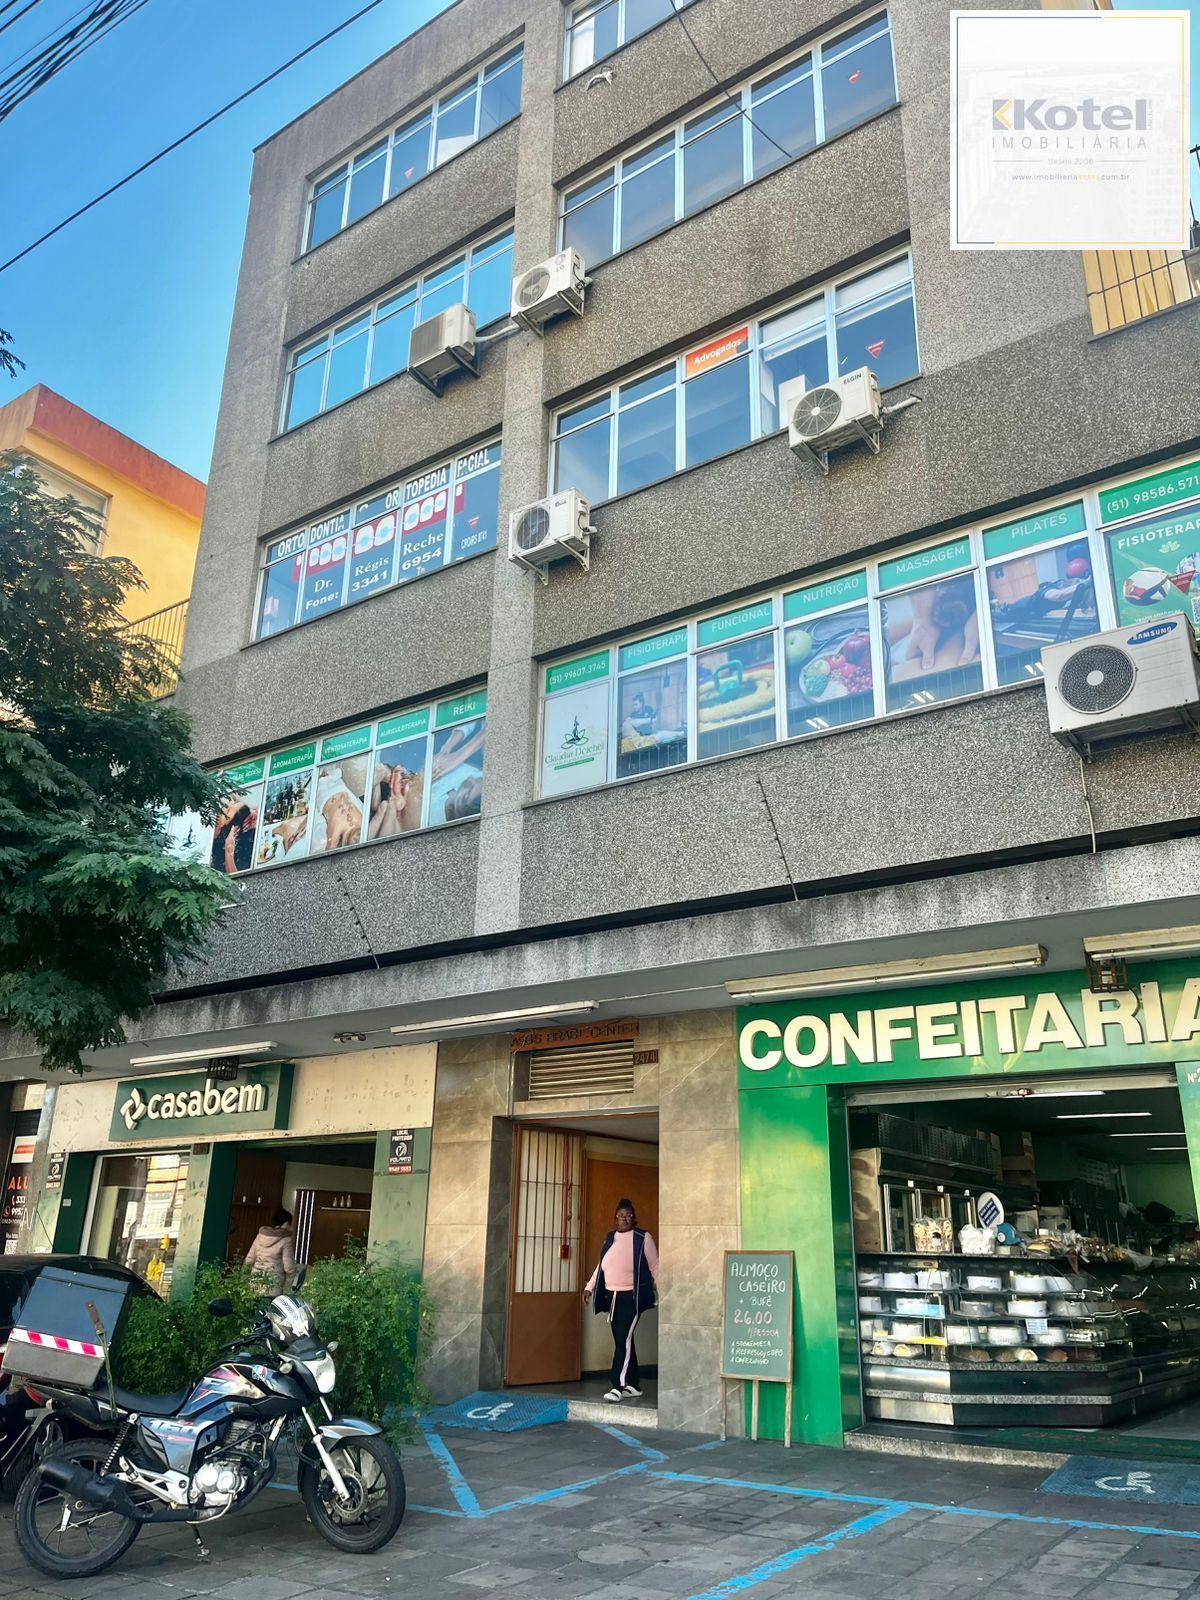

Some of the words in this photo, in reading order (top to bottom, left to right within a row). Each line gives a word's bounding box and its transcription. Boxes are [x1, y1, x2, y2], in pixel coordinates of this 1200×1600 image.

[693, 338, 742, 365] Advogados
[843, 373, 862, 385] ELGIN
[1106, 497, 1129, 514] (51)
[1011, 513, 1068, 539] PILATES
[314, 578, 333, 593] Dr.
[354, 556, 390, 577] Régis
[402, 531, 444, 556] Reche
[896, 545, 965, 574] MASSAGEM
[305, 591, 338, 611] Fone:
[351, 570, 388, 593] 3341
[402, 547, 442, 571] 6954
[711, 606, 770, 633] FUNCIONAL
[1133, 626, 1172, 641] SAMSUNG
[549, 674, 562, 687] (51)
[564, 660, 606, 681] 99607.3745
[453, 701, 476, 717] REIKI
[379, 718, 427, 738] AURICULOTERAPIA
[323, 736, 368, 755] VENTOSATERAPIA
[272, 752, 313, 770] AROMATERAPIA
[634, 1051, 656, 1064] 2474
[147, 1078, 266, 1121] casabem
[730, 1262, 779, 1280] ALMOÇO
[738, 1280, 786, 1294] CASEIRO
[734, 1309, 773, 1325] 26.00
